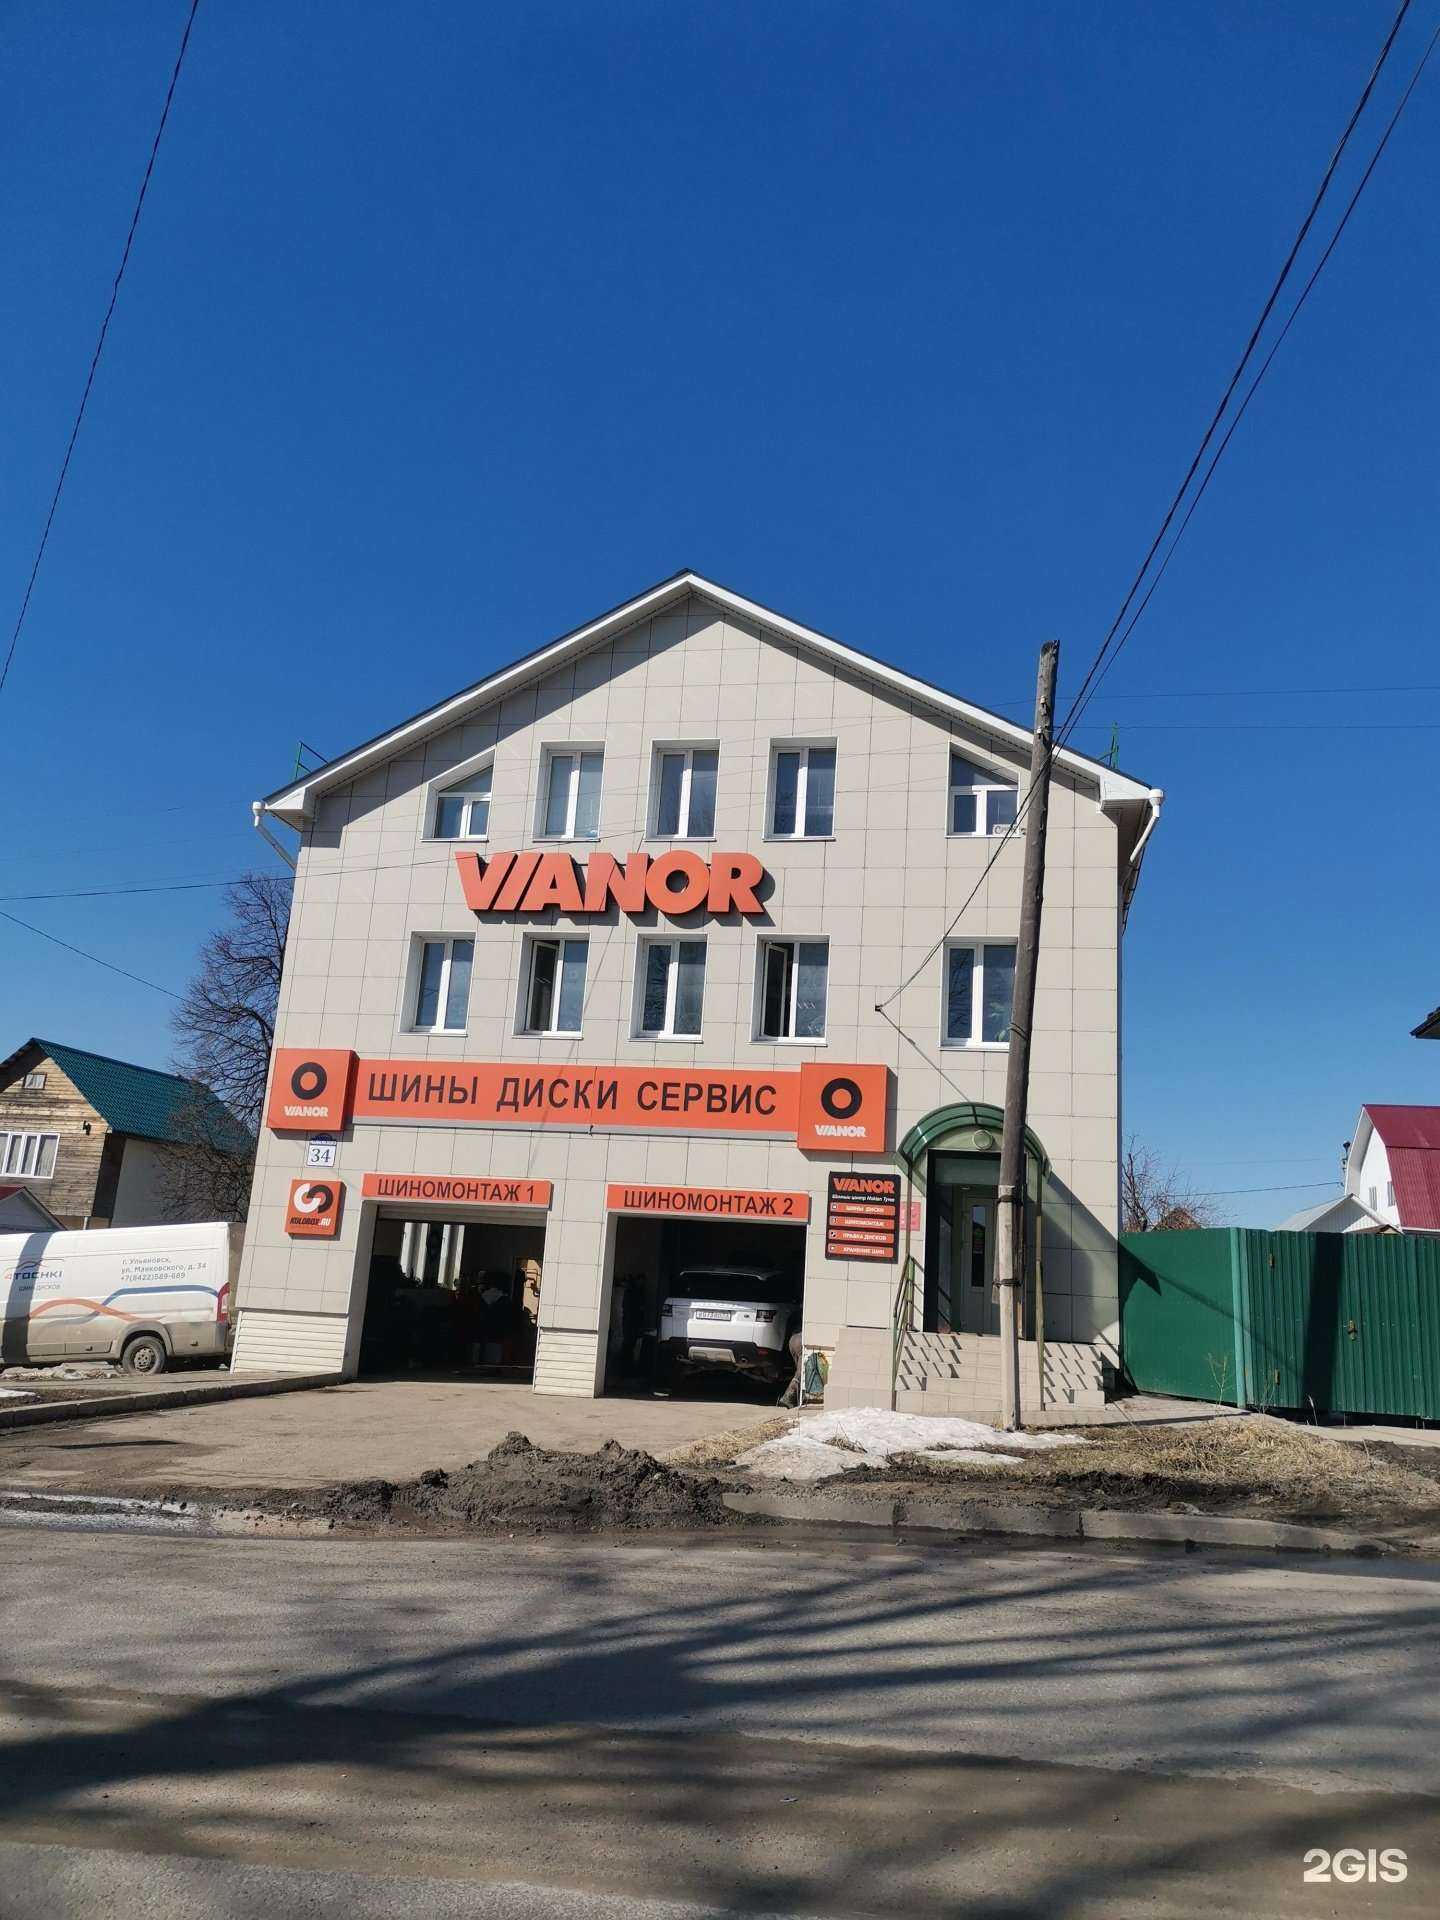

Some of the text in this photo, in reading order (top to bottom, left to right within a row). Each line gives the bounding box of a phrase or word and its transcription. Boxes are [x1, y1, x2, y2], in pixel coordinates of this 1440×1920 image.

[455, 850, 764, 914] VIANOR
[368, 1072, 778, 1116] ШИНЫ ДИСКИ СЕРВИС
[284, 1105, 329, 1118] VIANOR
[815, 1124, 867, 1138] VIANOR
[311, 1148, 331, 1163] 34
[377, 1178, 535, 1202] ШИНОМОНТАЖ 1
[833, 1178, 895, 1193] VIANOR
[624, 1190, 793, 1215] ШИНОМОНТАЖ 2
